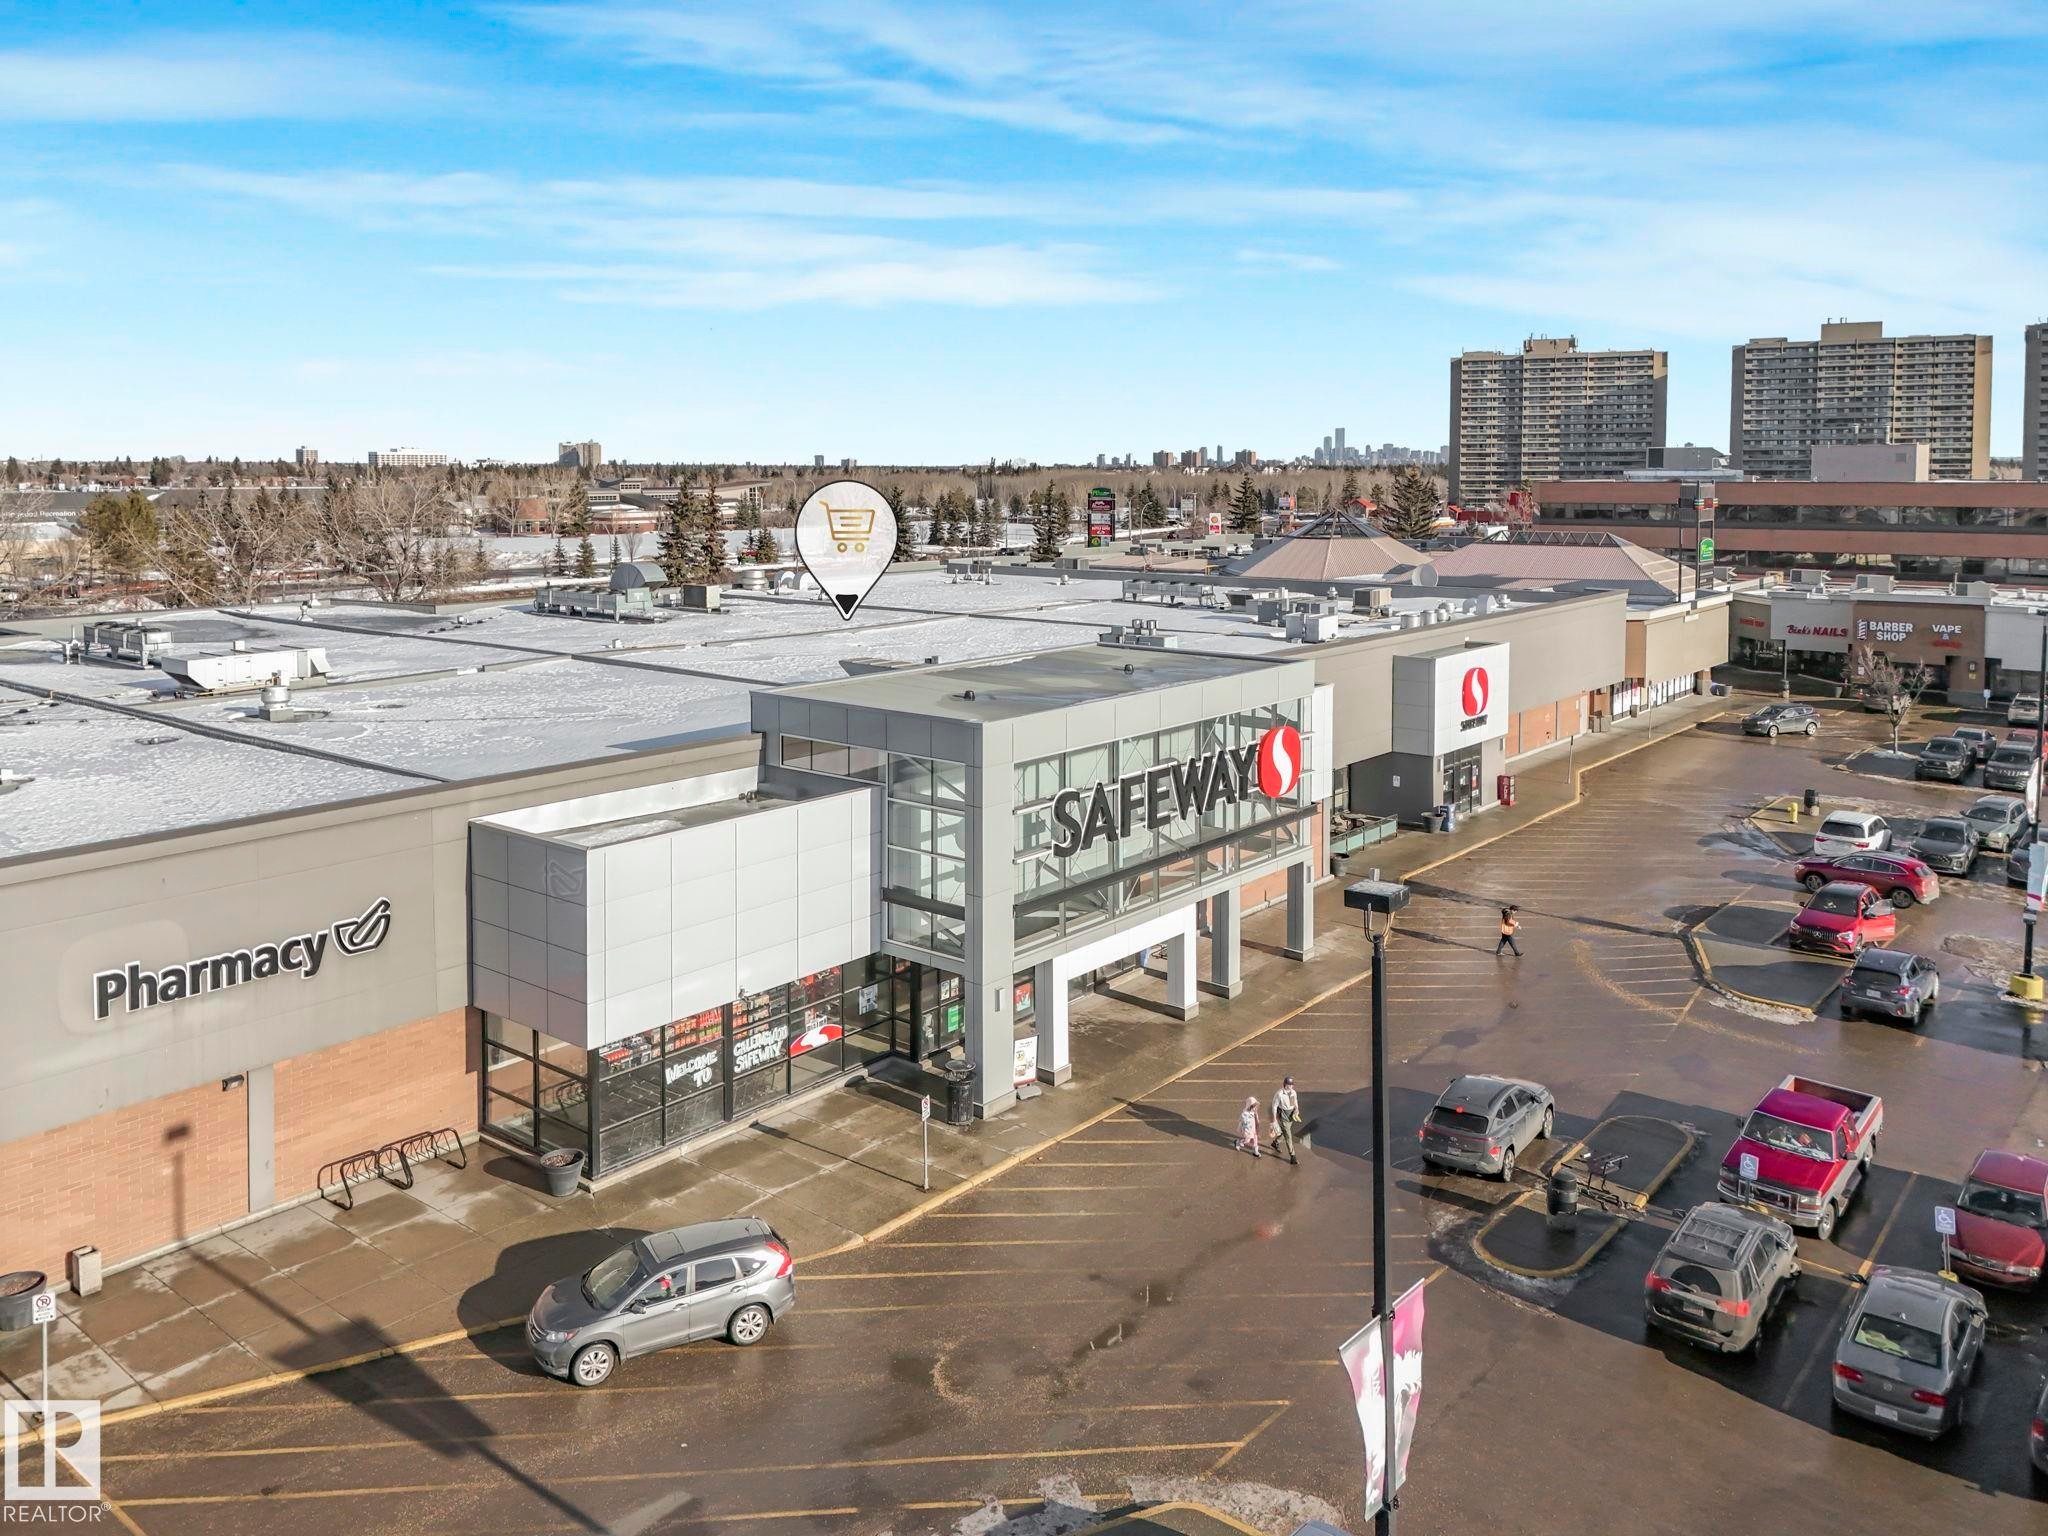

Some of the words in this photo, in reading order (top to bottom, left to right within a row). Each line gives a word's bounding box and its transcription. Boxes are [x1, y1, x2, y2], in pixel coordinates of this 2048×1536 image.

[1812, 626, 1849, 637] NAILS
[1869, 621, 1914, 633] BARBER
[1876, 631, 1907, 641] SHOP
[1931, 624, 1962, 634] VAPE
[1052, 741, 1261, 858] SAFEWAY
[94, 930, 329, 1020] Pharmacy
[665, 1049, 718, 1085] WELCOME
[733, 1040, 784, 1074] SAFEWAY
[693, 1066, 713, 1088] TO
